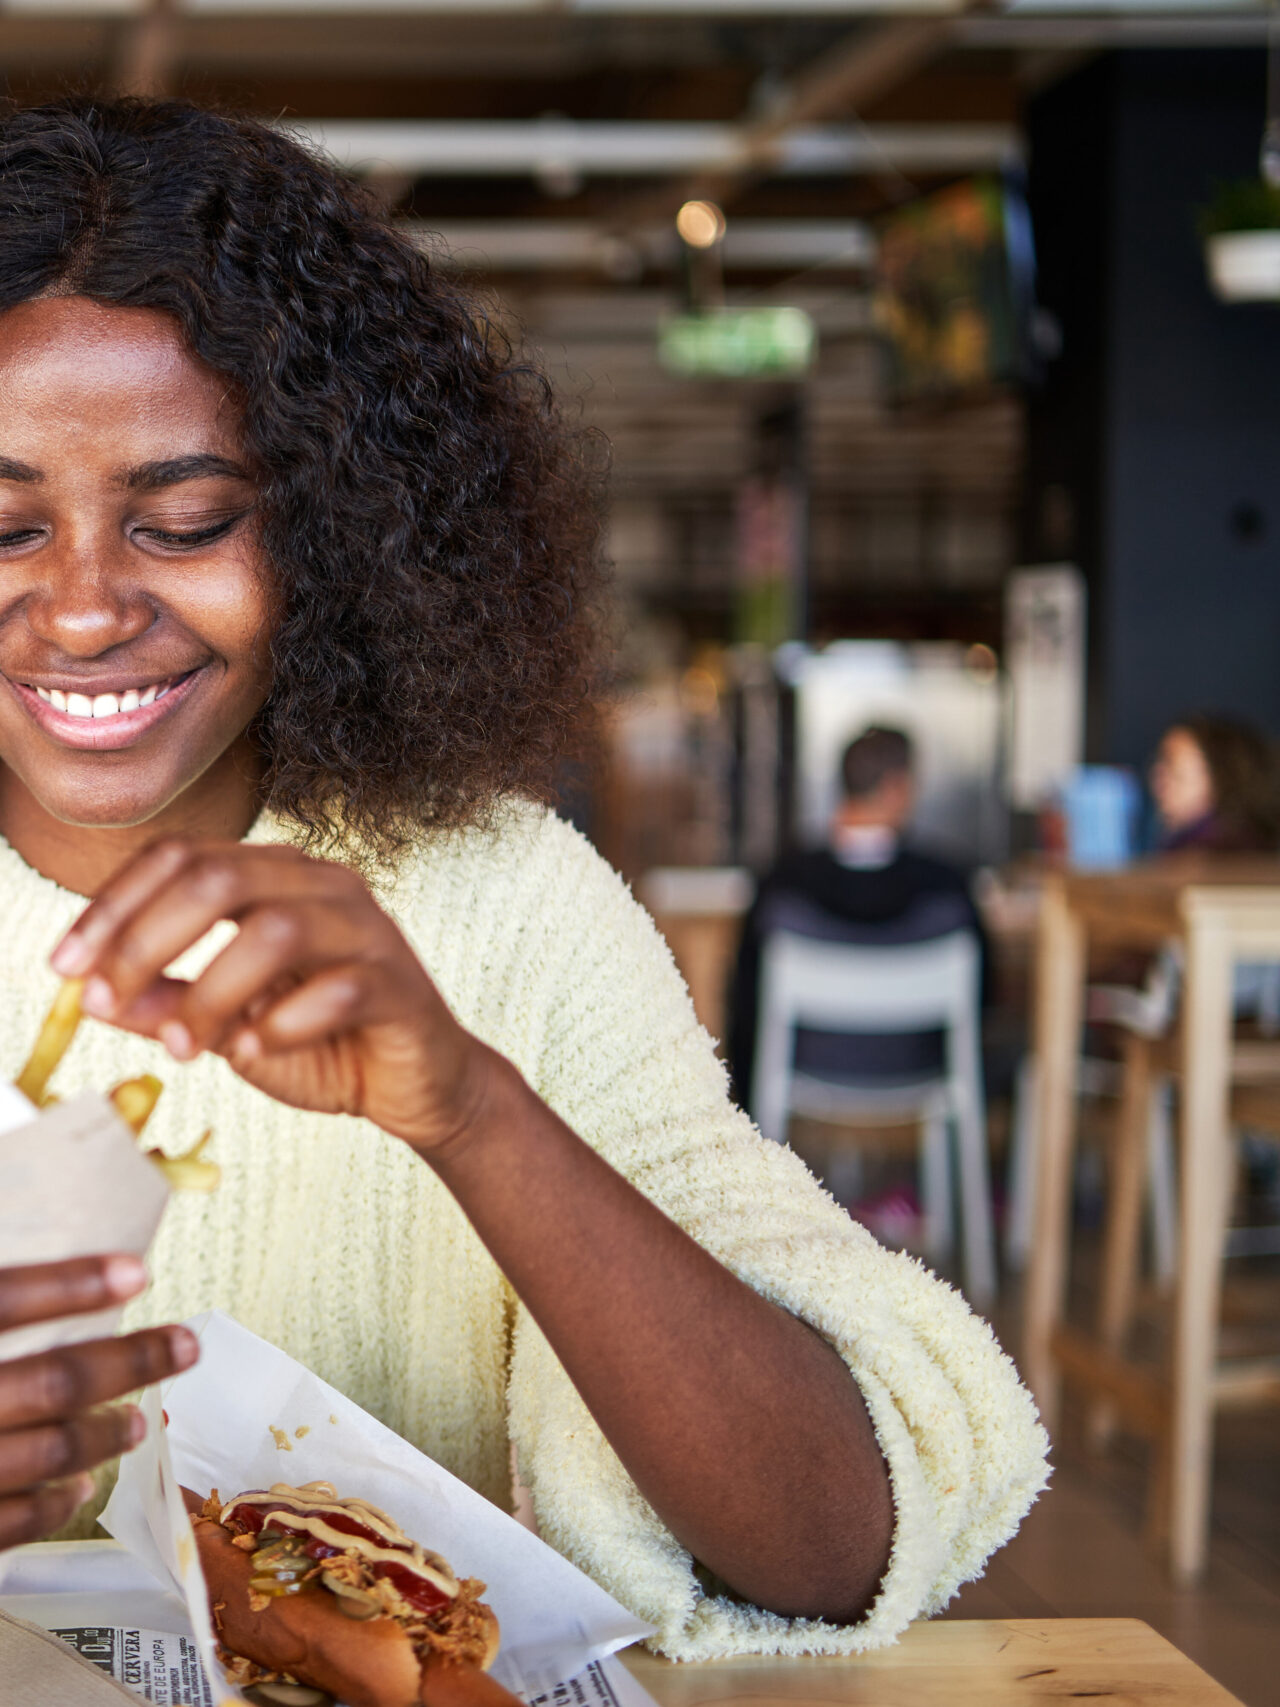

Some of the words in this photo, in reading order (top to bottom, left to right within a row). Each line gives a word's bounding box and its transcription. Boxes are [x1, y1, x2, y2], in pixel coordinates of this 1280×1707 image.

[125, 1630, 140, 1684] CERVERA
[153, 1639, 166, 1674] EUROPA
[154, 1676, 167, 1687] DE
